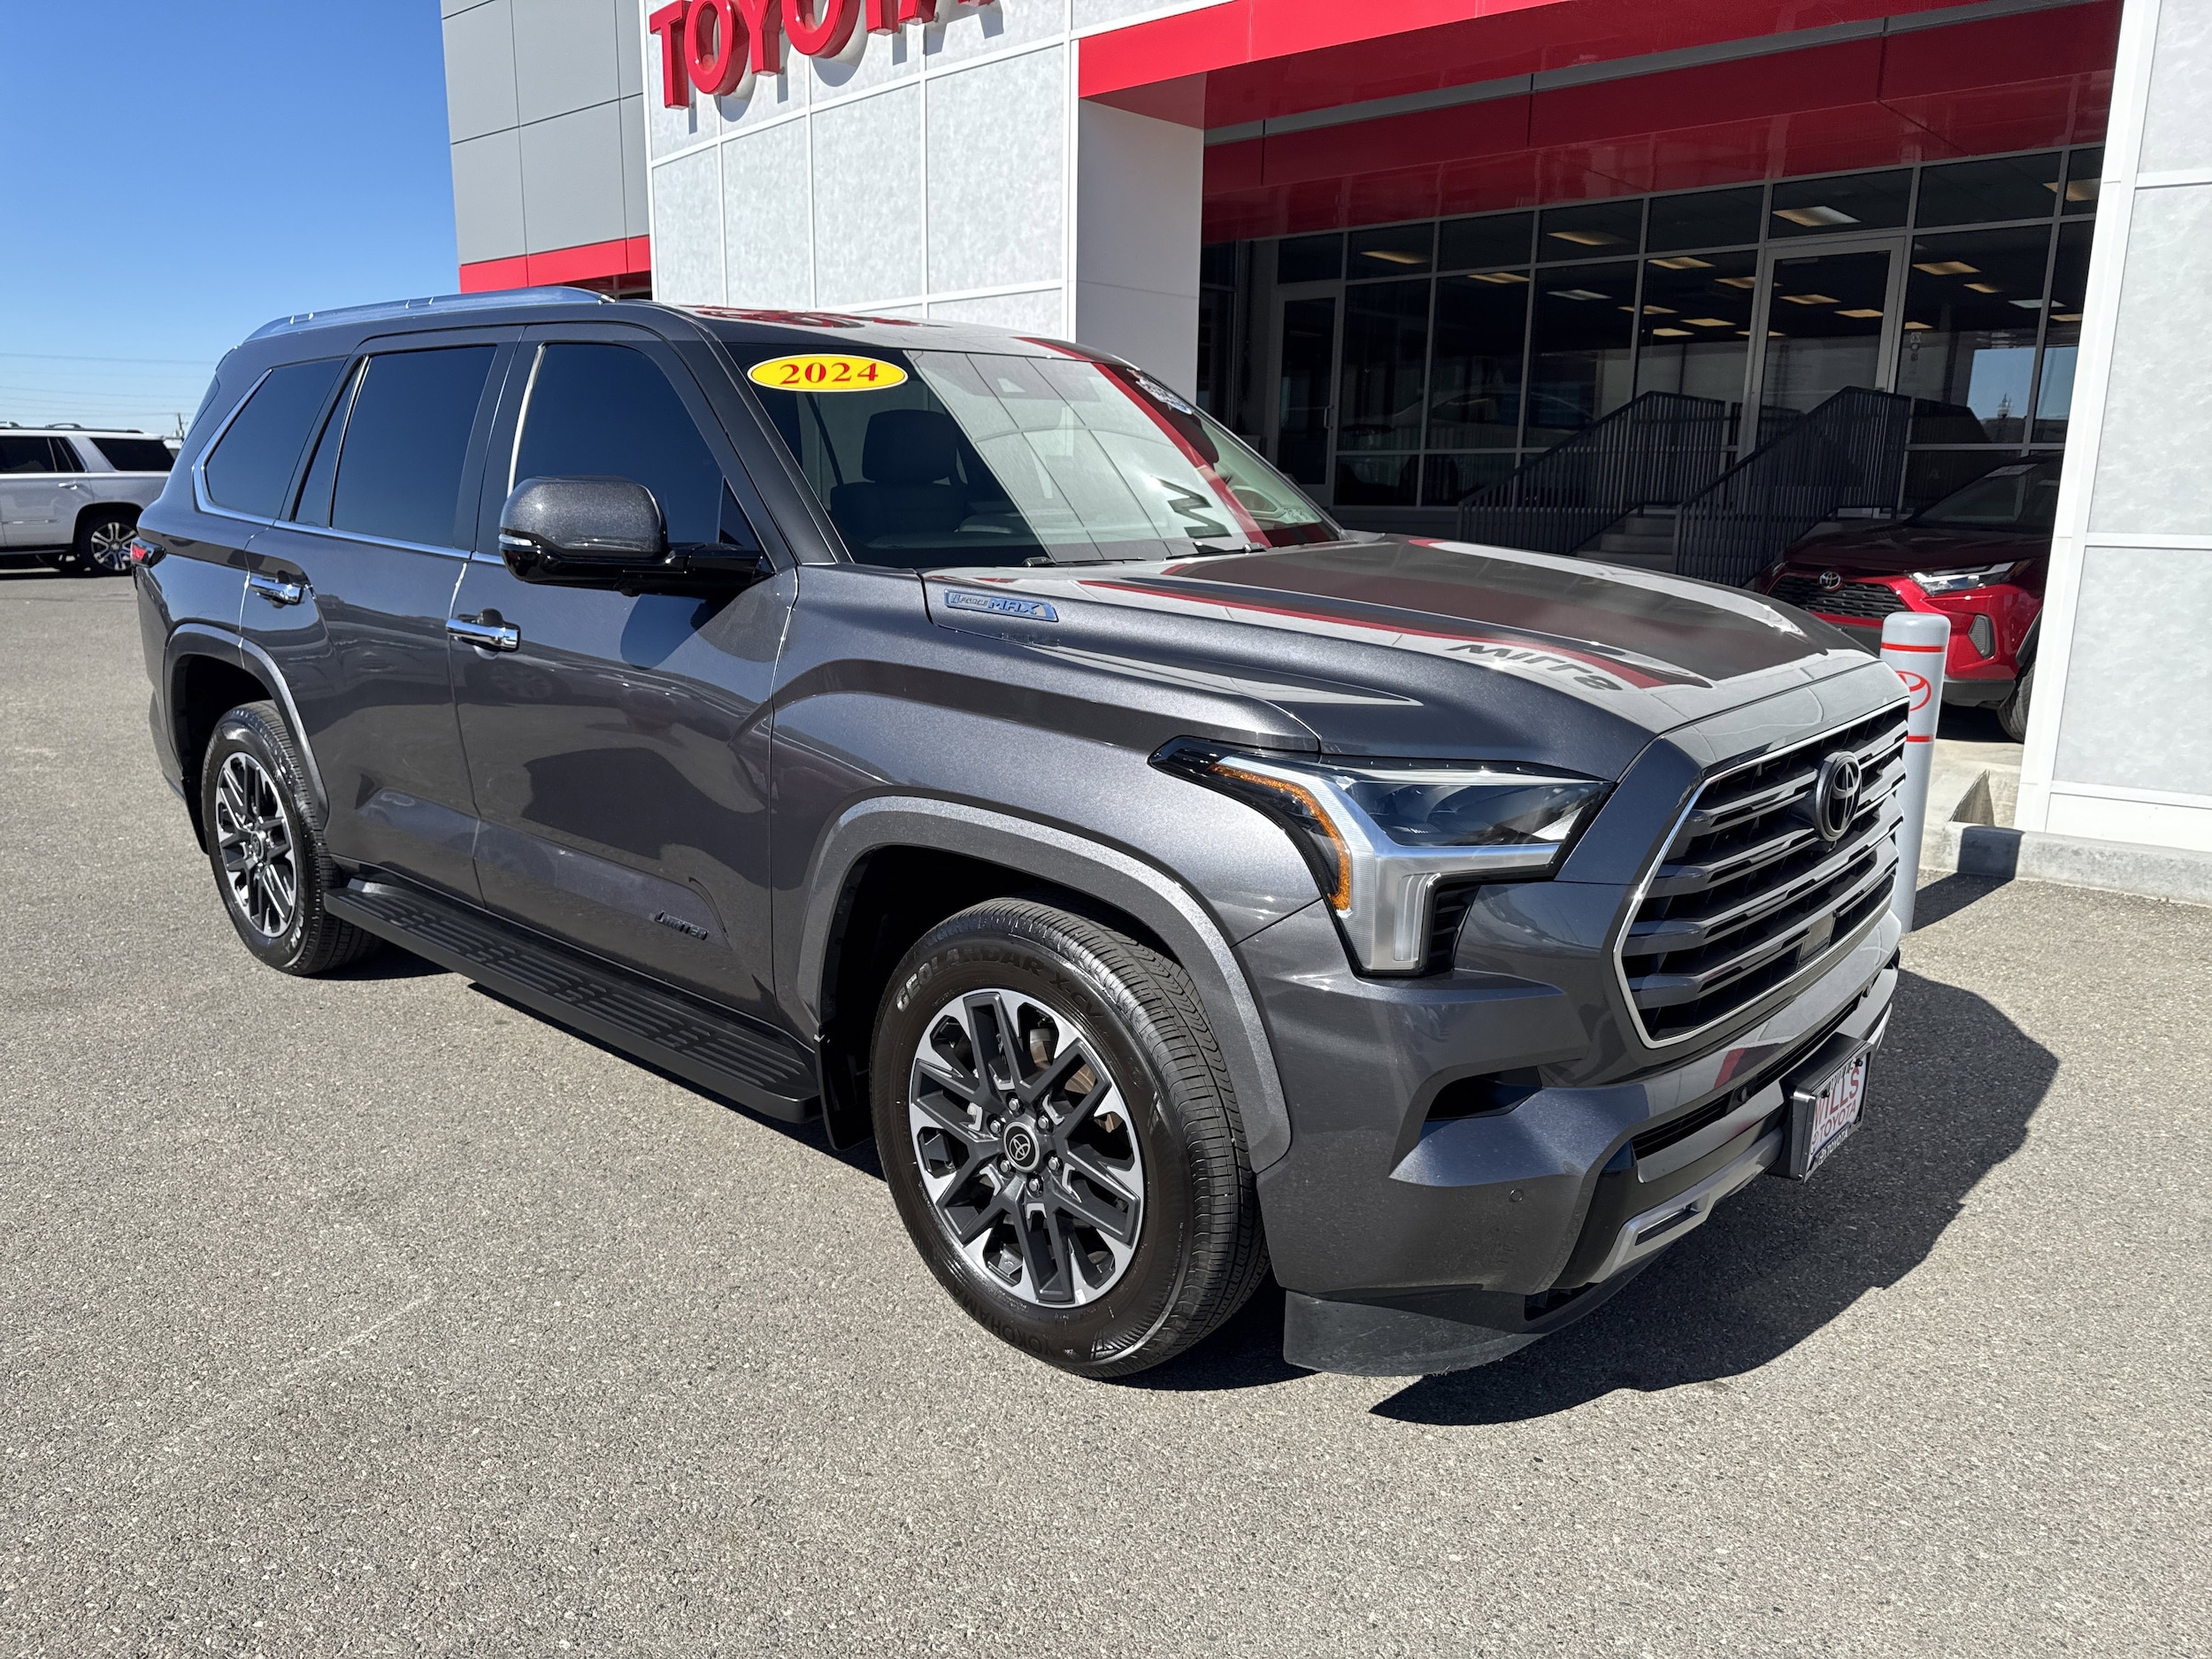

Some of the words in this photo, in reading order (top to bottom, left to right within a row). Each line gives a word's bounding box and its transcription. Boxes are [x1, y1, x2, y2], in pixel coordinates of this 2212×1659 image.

[649, 0, 993, 110] TOYO
[780, 363, 879, 385] 2024
[987, 598, 1041, 615] MAX
[1815, 1065, 1859, 1132] WILLS
[1820, 1099, 1856, 1142] TOYOTA
